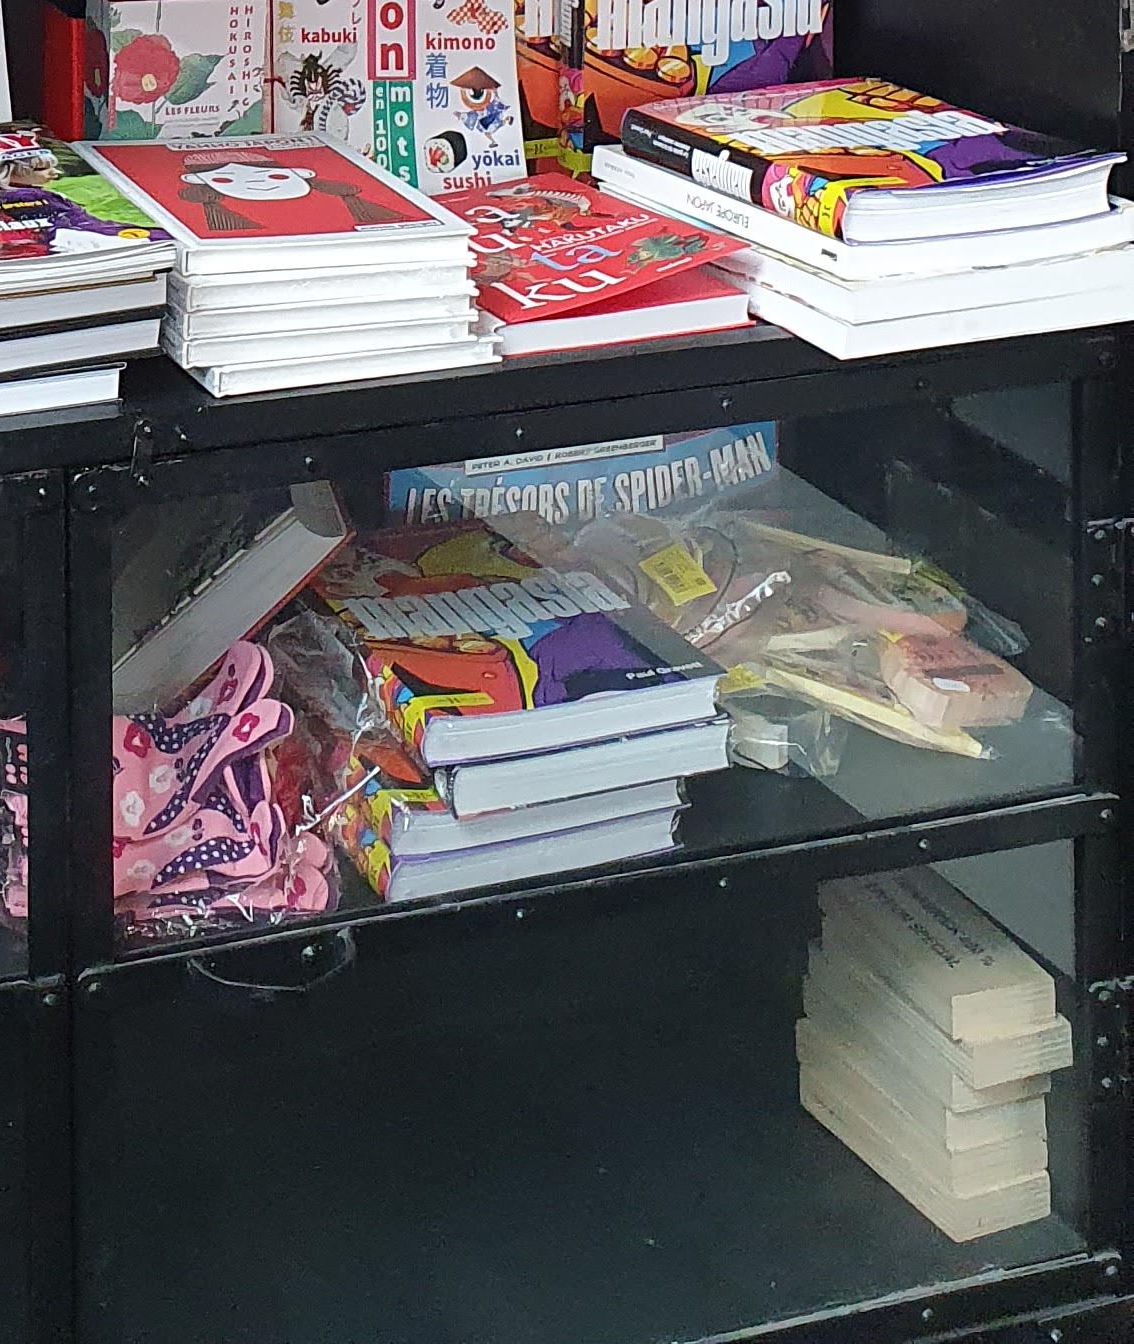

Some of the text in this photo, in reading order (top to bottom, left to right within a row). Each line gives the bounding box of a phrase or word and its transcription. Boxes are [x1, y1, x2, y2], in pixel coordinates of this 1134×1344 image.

[301, 26, 358, 45] kabuki
[425, 31, 497, 51] kimono
[229, 6, 239, 95] HOKUSAI
[424, 52, 449, 110] 着物
[390, 84, 411, 182] mots
[442, 171, 492, 190] sushi
[716, 205, 749, 227] EUROPE
[516, 454, 544, 467] DAVID
[406, 431, 772, 523] LES TRÉSORS DE SPIDER-MAN
[343, 570, 631, 640] mangasia
[625, 669, 655, 682] Paul
